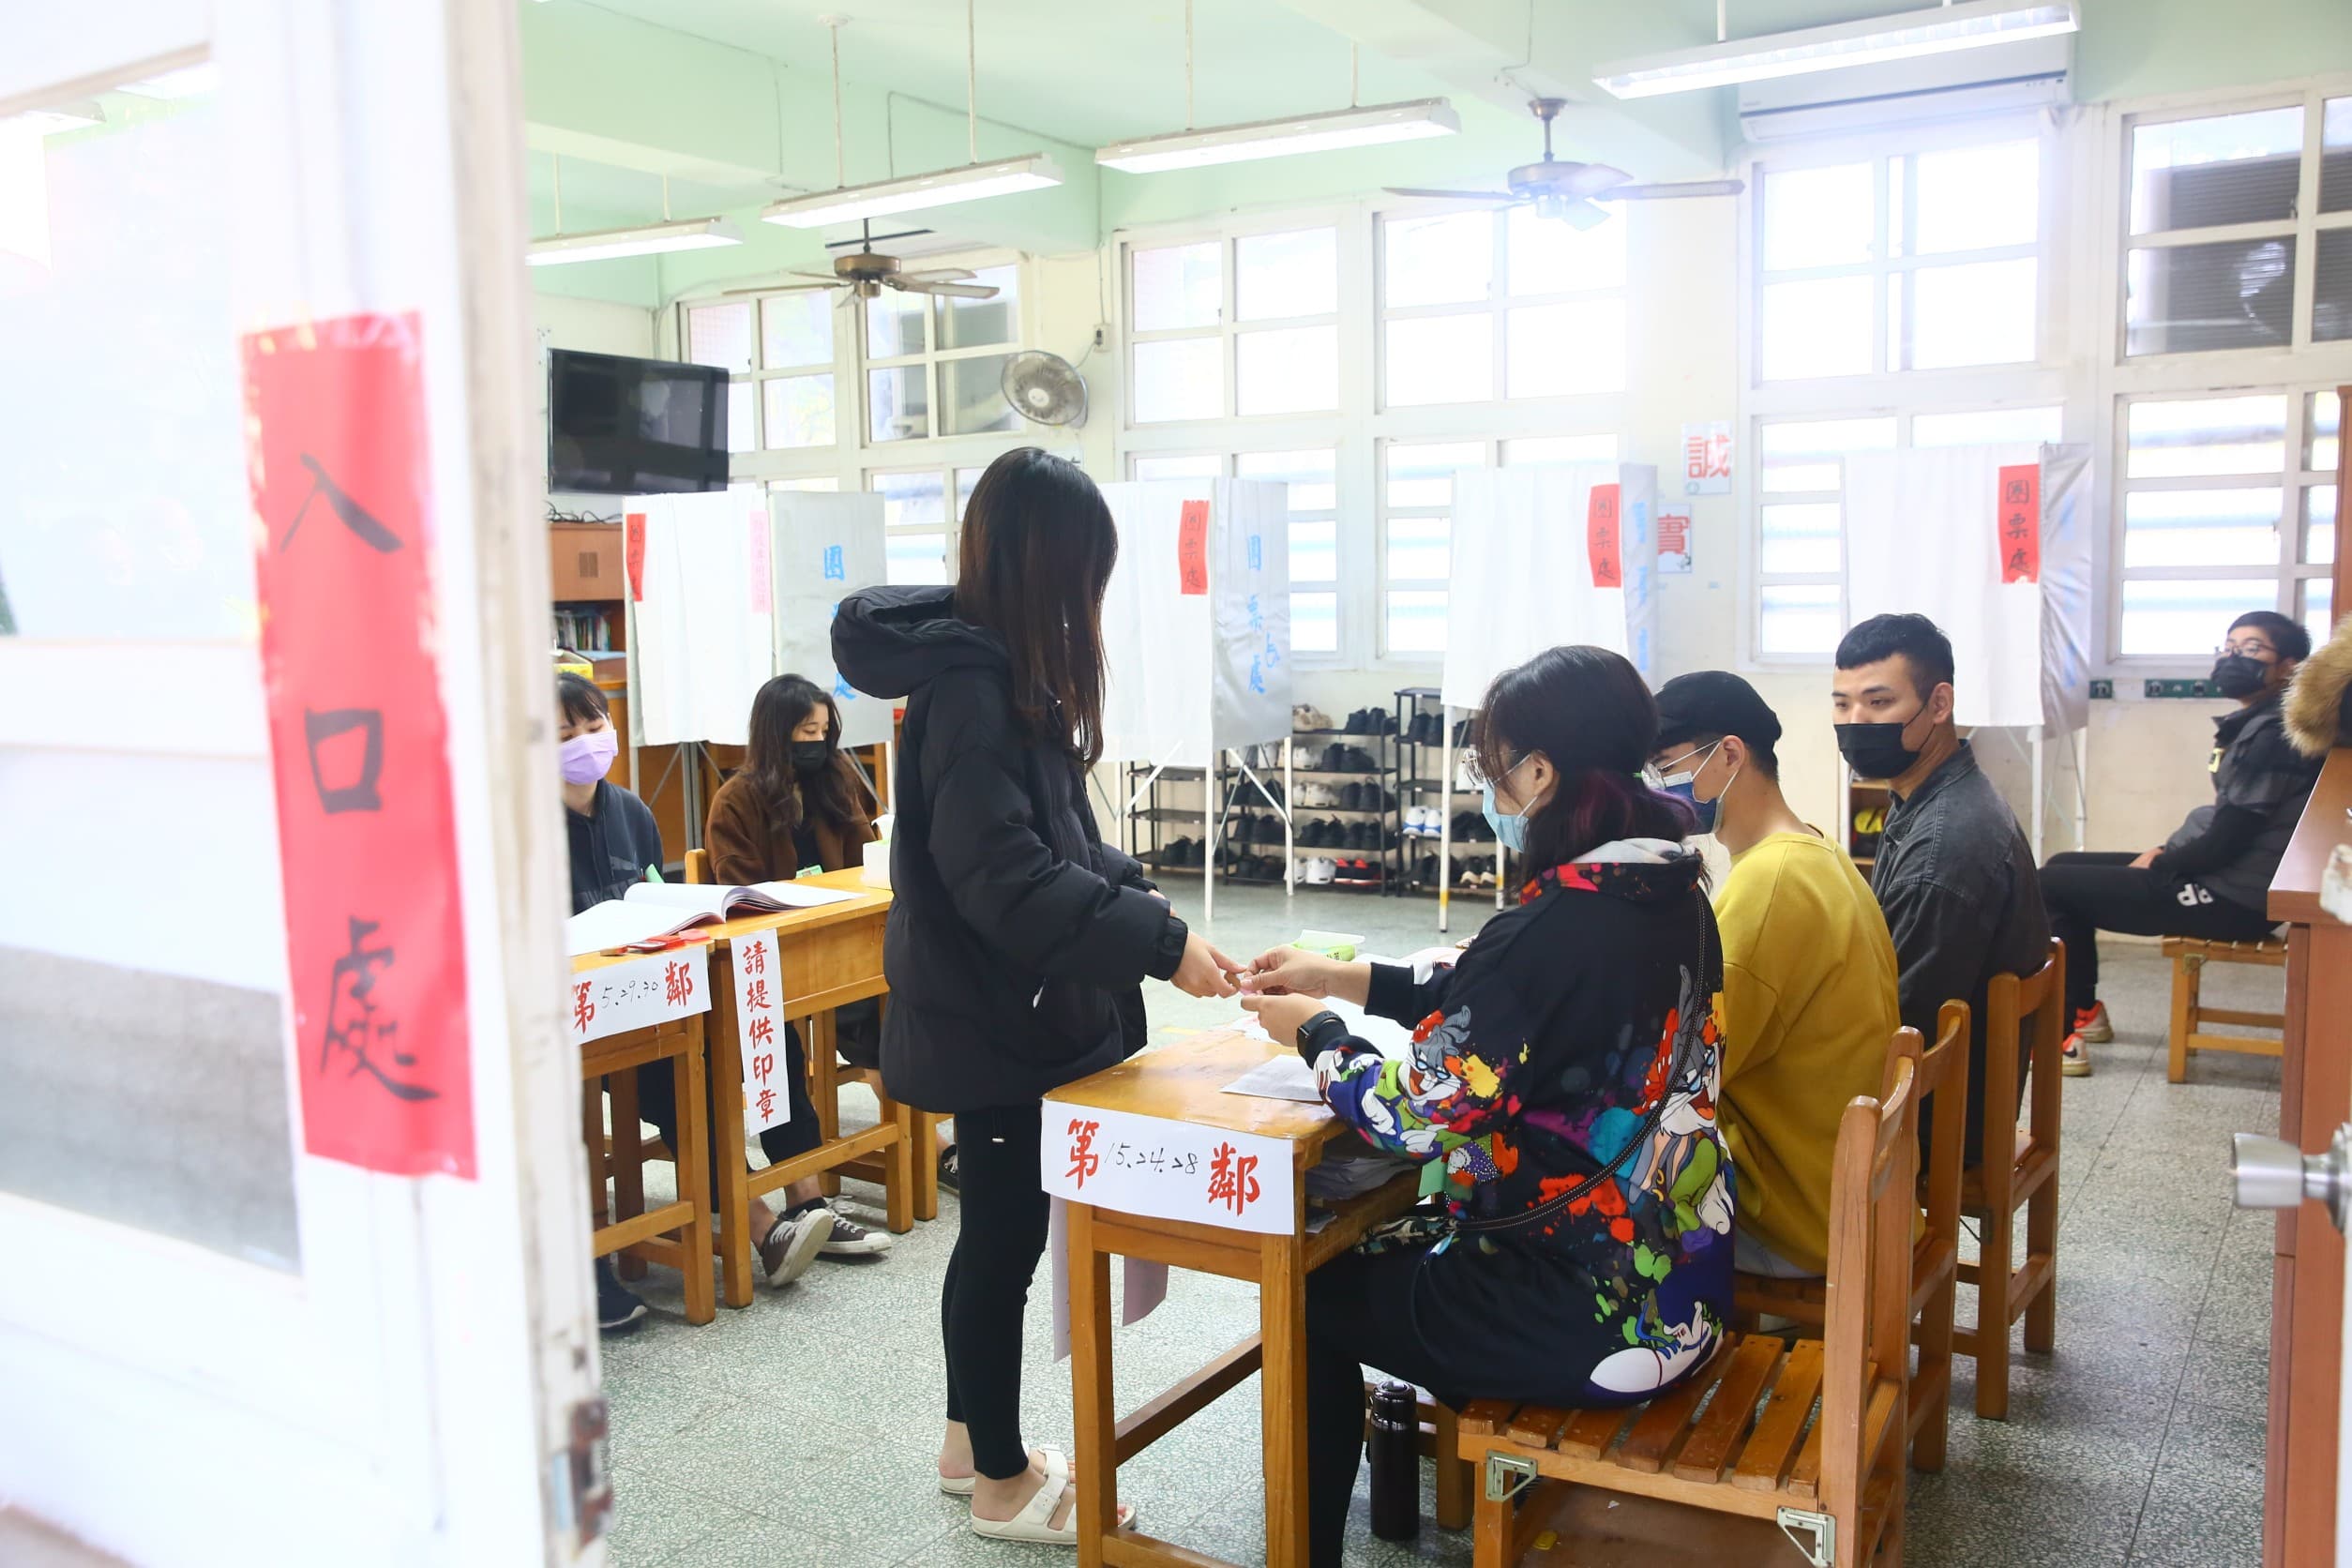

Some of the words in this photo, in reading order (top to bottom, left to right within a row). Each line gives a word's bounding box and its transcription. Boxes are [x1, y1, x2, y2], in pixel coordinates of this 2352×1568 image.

[1688, 435, 1730, 478] 誠
[280, 454, 442, 1103] 入口處
[743, 940, 777, 1123] 請提供印章
